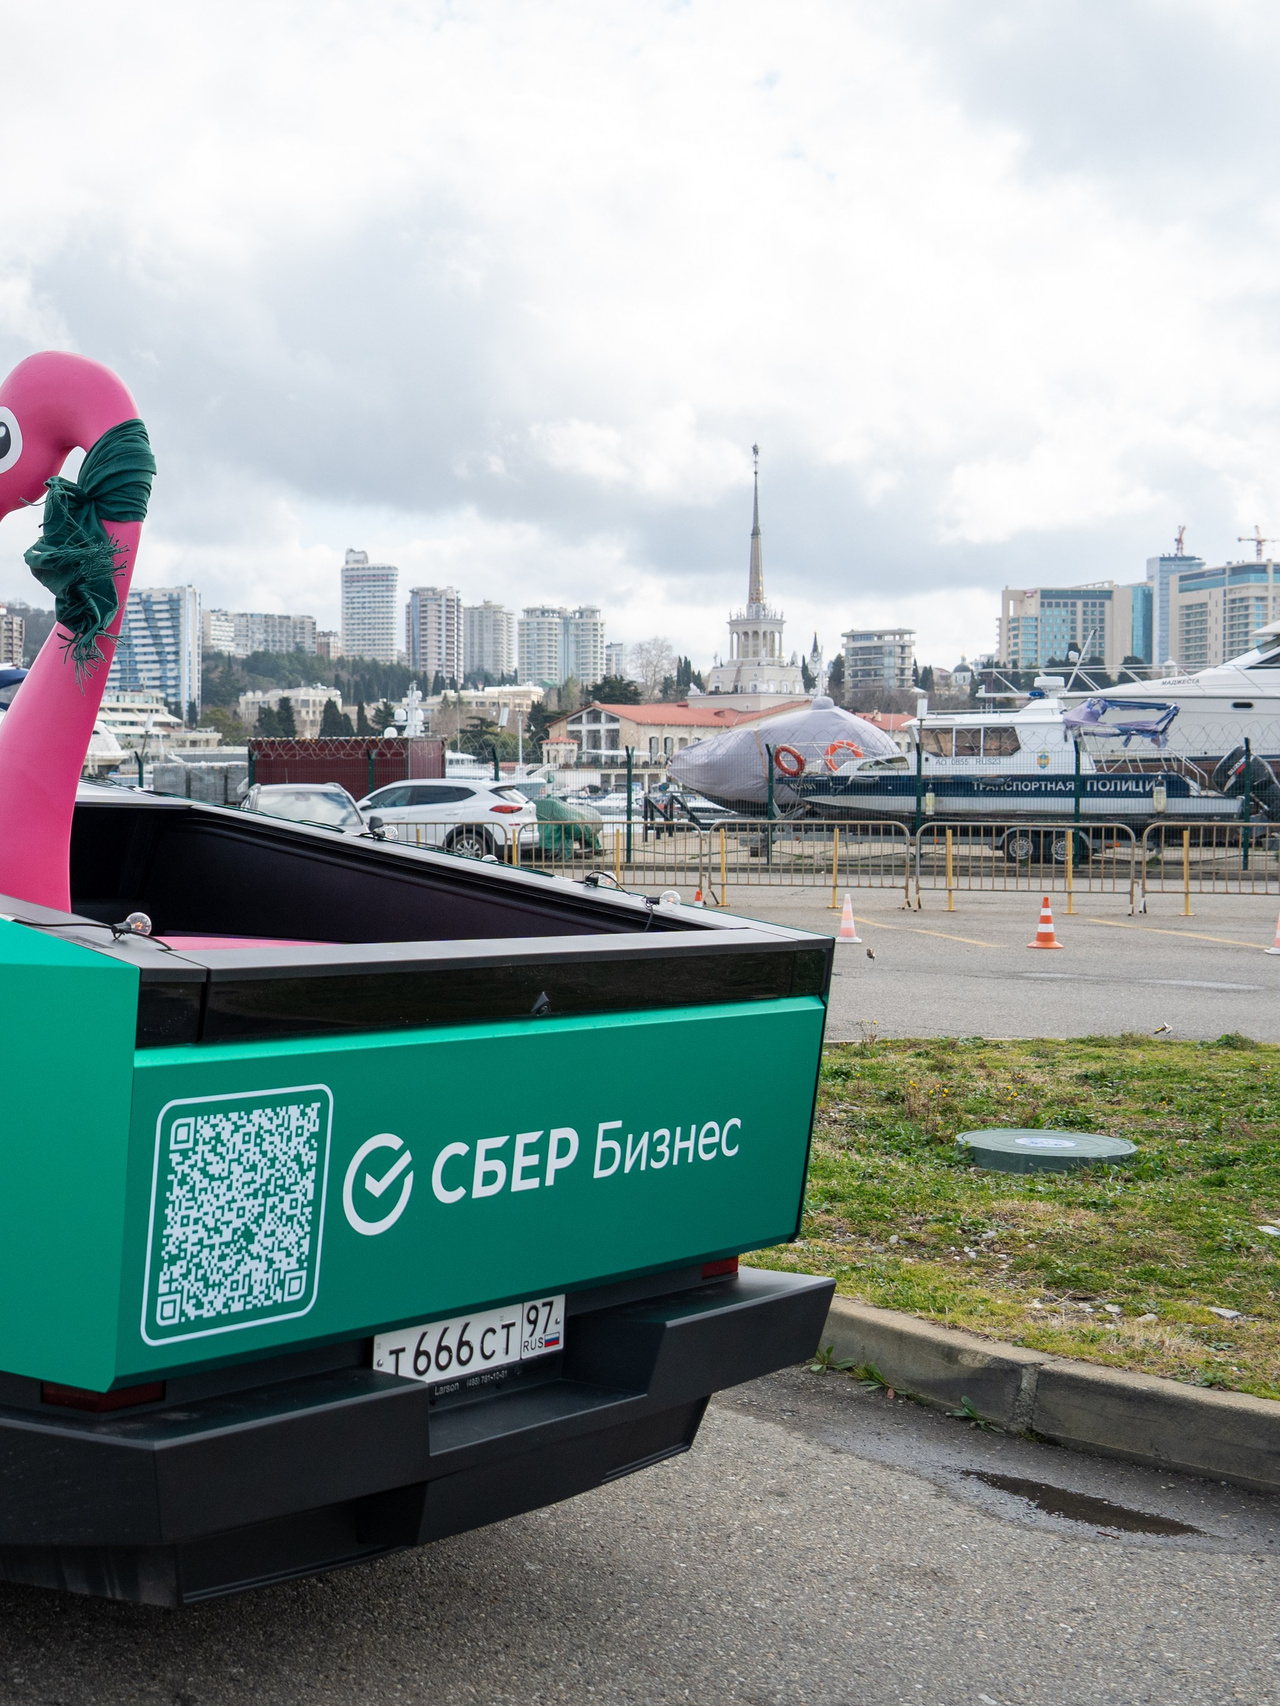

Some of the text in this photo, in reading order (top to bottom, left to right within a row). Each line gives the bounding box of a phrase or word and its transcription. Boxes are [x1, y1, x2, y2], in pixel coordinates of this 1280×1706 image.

[1161, 678, 1200, 686] МАДЖЕСТА
[431, 1117, 742, 1204] СБЕР Бизнес
[526, 1300, 555, 1338] 97
[523, 1337, 544, 1353] RUS
[434, 1382, 460, 1396] Larson
